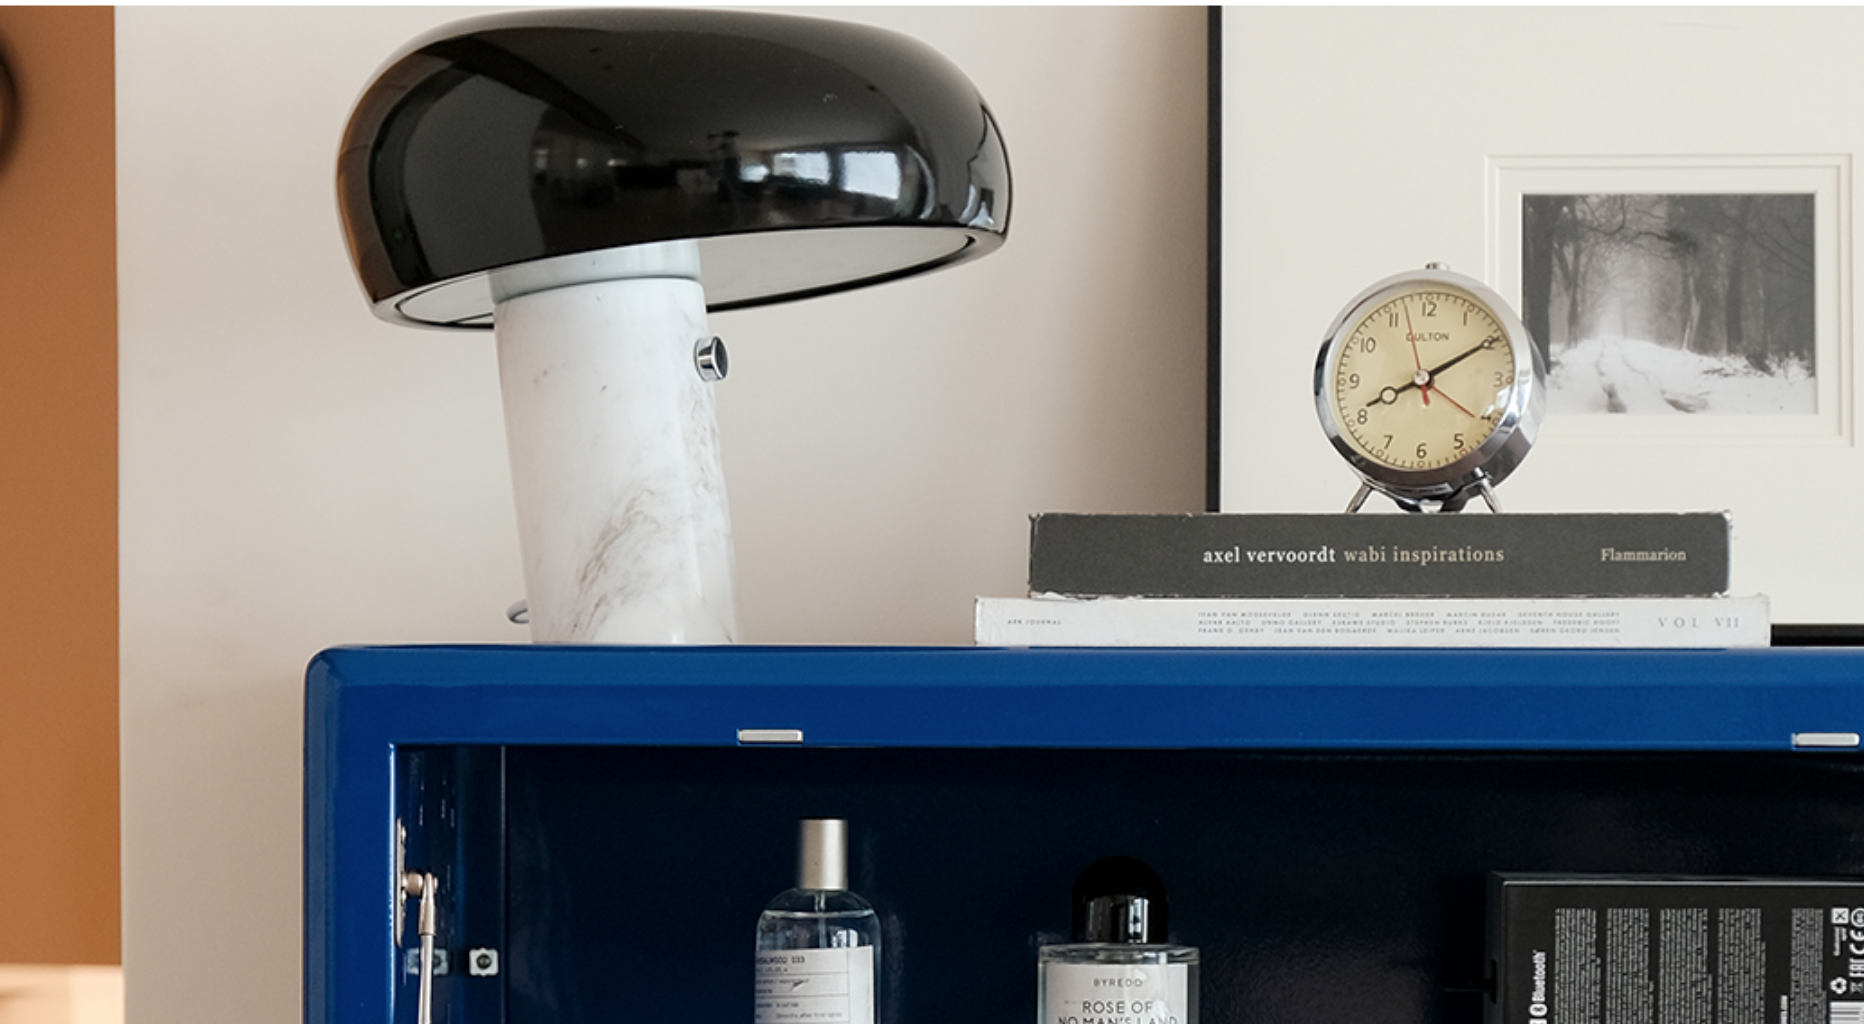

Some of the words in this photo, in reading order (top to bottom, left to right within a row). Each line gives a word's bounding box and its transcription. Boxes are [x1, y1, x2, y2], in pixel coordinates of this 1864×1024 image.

[1421, 301, 1437, 317] 12
[1389, 312, 1399, 327] 11
[1463, 312, 1468, 326] 1
[1406, 332, 1450, 341] DULTON
[1360, 337, 1376, 353] 10
[1349, 373, 1360, 389] 9
[1494, 371, 1503, 388] 3
[1357, 409, 1368, 425] 8
[1383, 435, 1393, 450] 7
[1454, 433, 1464, 449] 5
[1416, 443, 1427, 459] 6
[1203, 546, 1240, 563] axel
[1247, 546, 1336, 563] vervoordt
[1344, 546, 1387, 563] wabi
[1392, 546, 1505, 566] inspirations
[1601, 547, 1687, 562] Flammarion
[1658, 616, 1700, 628] VOL
[1715, 616, 1740, 628] VII
[1093, 978, 1143, 987] BYREDO
[1532, 951, 1546, 1002] Bluetooth
[1082, 1001, 1125, 1014] ROSE
[1131, 1001, 1153, 1014] OF
